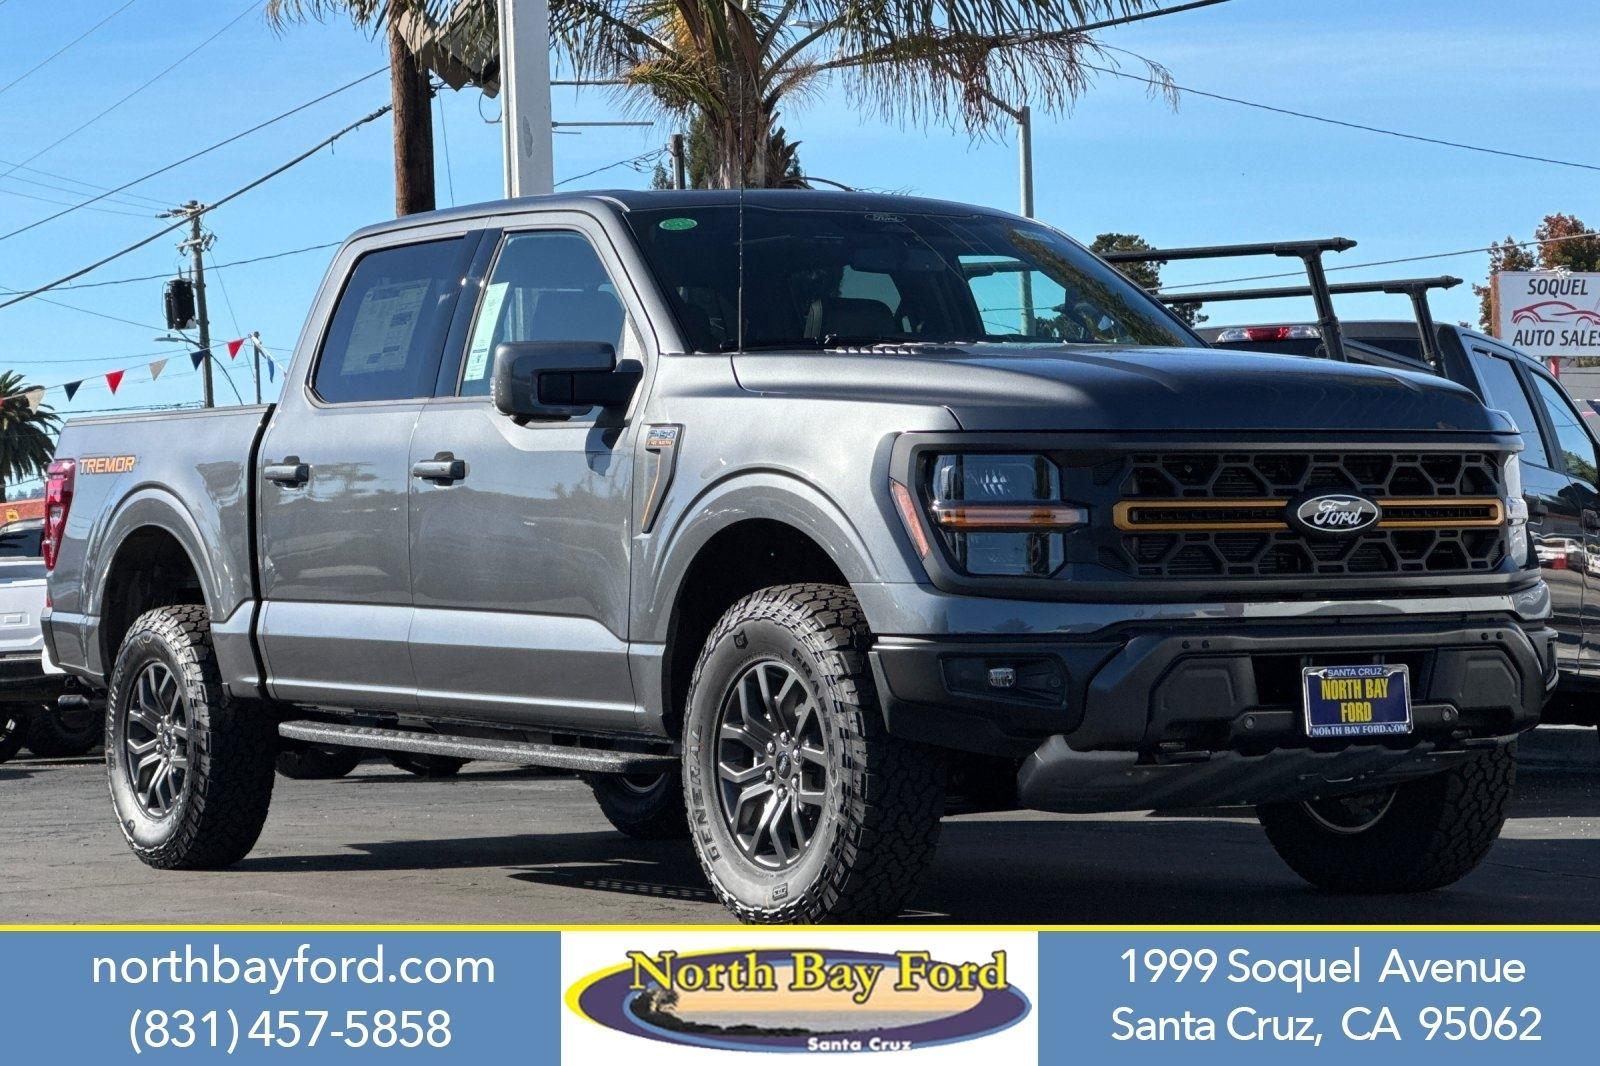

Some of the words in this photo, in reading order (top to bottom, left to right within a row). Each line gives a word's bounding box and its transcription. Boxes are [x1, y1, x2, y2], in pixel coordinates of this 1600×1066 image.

[1528, 279, 1588, 298] SOQUEL
[1512, 330, 1555, 346] AUTO
[1560, 330, 1600, 346] SALE
[79, 456, 136, 474] TREMOR
[1313, 499, 1363, 525] Ford
[1327, 669, 1357, 677] SANTA
[1358, 667, 1382, 676] CRUZ
[1321, 678, 1362, 700] NORTH
[1365, 678, 1389, 699] BAY
[1340, 701, 1373, 723] FORD
[1312, 727, 1342, 736] NORTH
[1344, 726, 1360, 735] BAY
[690, 726, 722, 862] GENERAL
